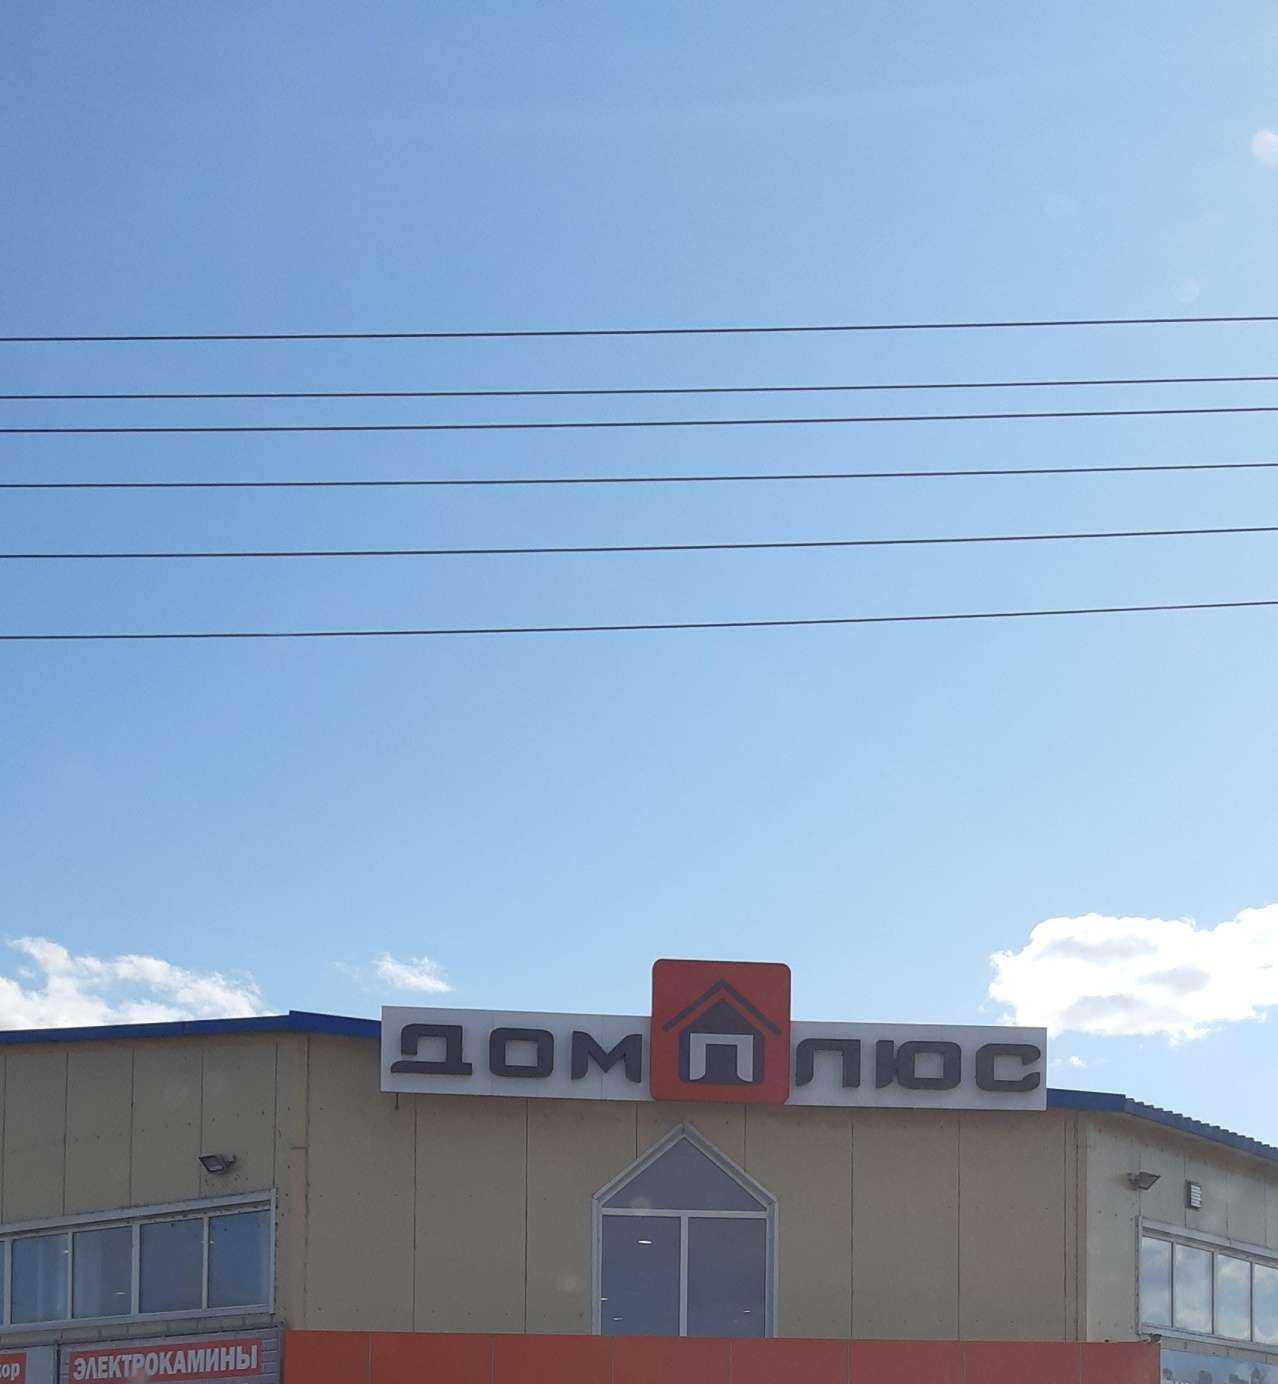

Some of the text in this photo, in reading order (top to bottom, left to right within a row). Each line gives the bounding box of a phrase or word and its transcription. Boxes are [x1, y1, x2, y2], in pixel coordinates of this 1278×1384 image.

[390, 1023, 643, 1084] ДОМ
[0, 1363, 20, 1380] ор
[73, 1345, 258, 1381] ЭЛЕКТРОКАМИНЫ
